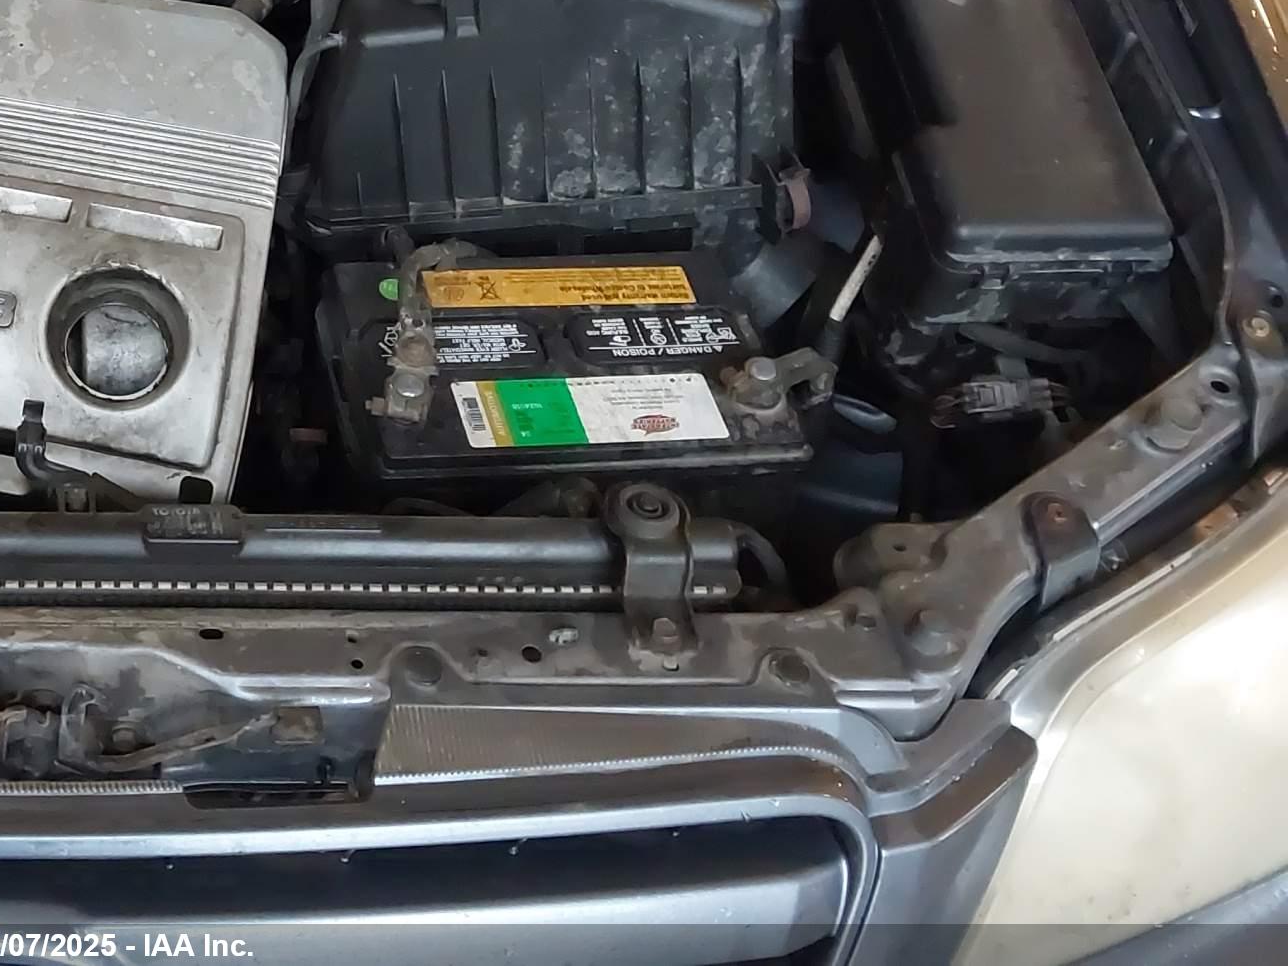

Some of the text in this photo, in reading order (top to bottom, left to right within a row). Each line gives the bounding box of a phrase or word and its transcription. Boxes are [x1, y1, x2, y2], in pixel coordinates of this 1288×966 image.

[612, 345, 713, 357] DANGER / POISON
